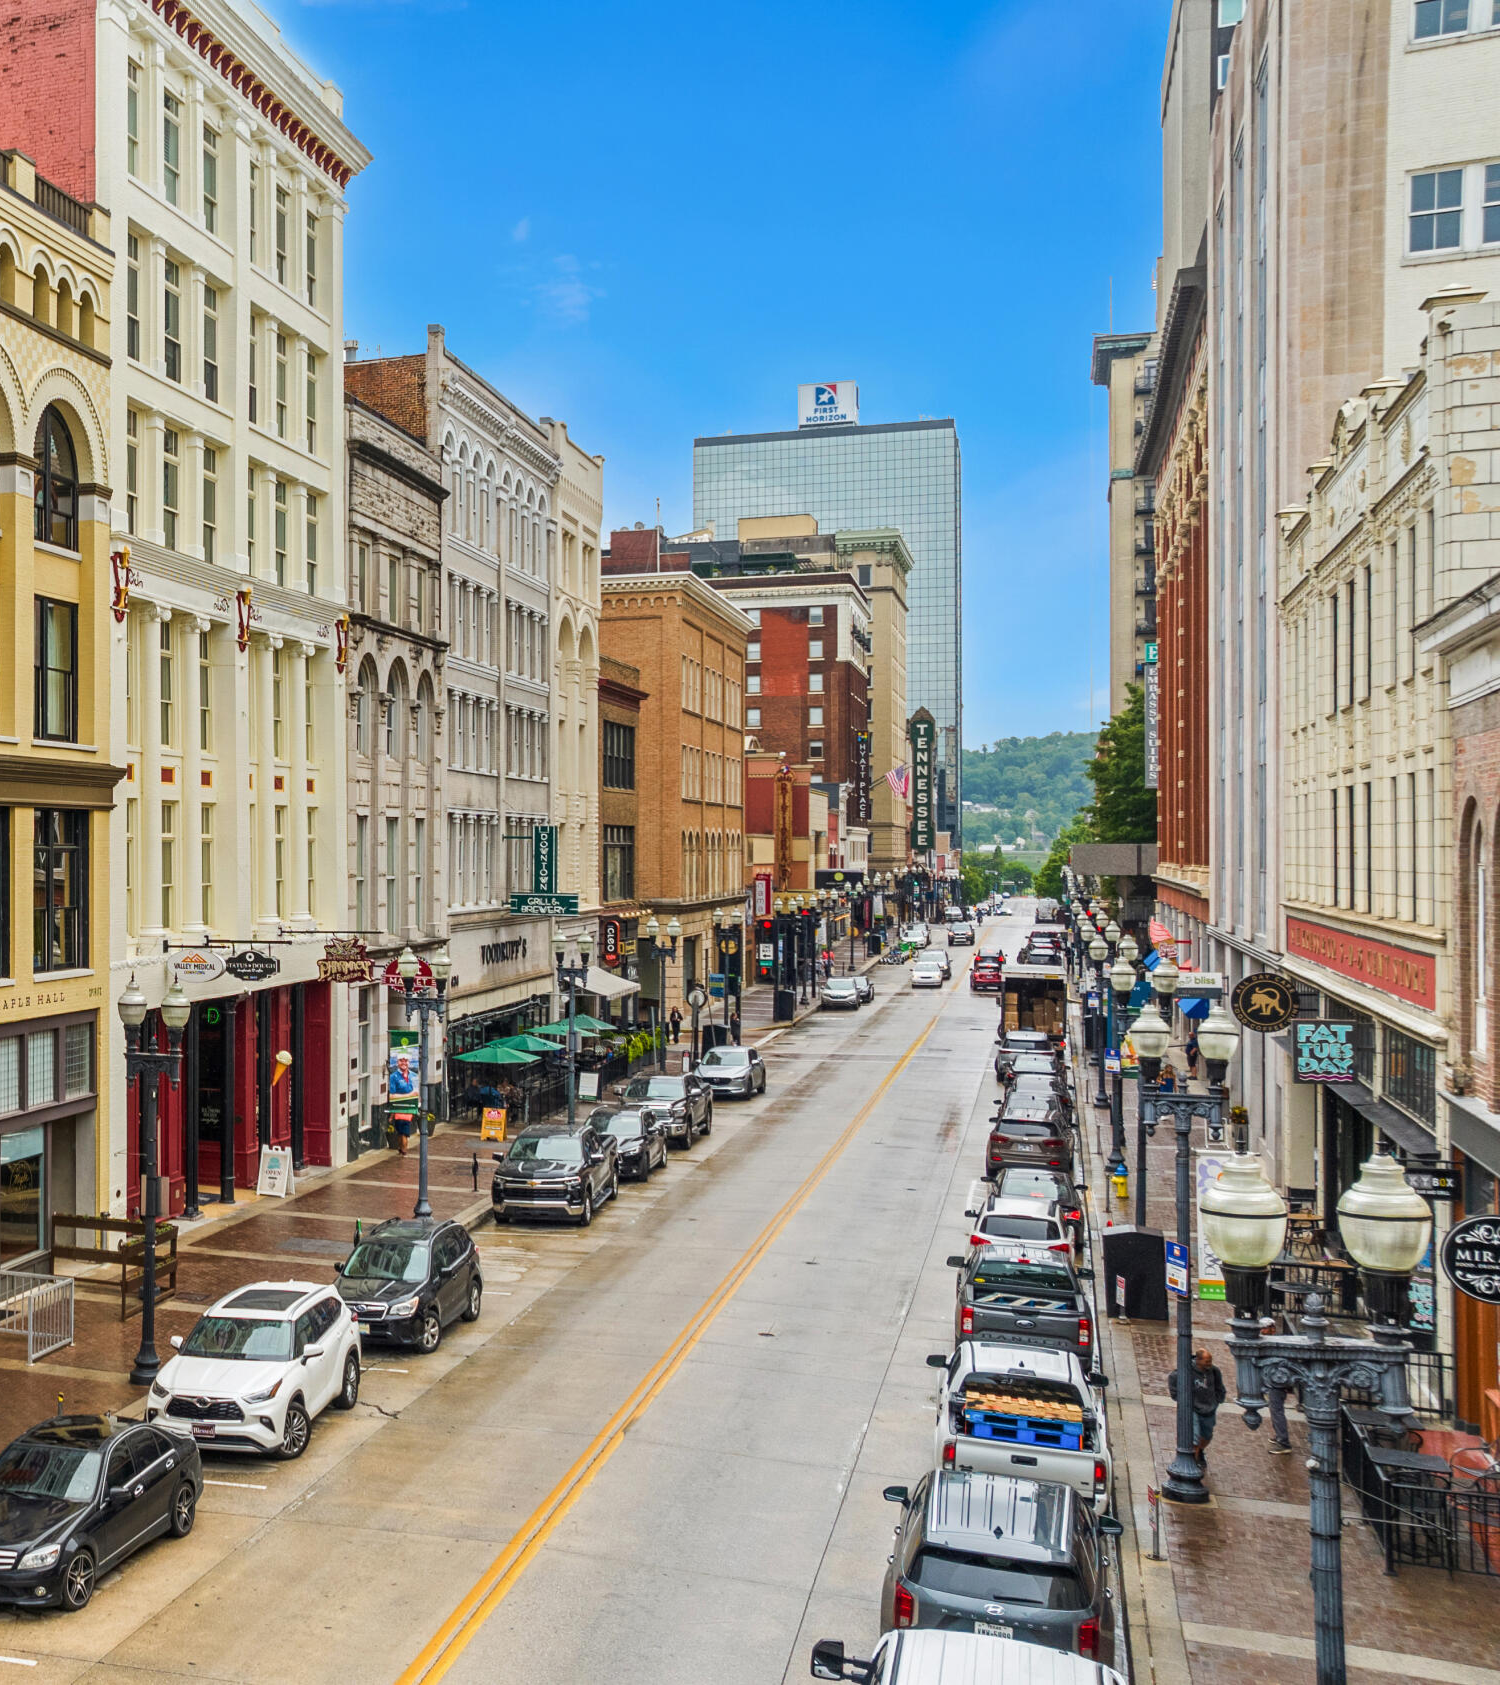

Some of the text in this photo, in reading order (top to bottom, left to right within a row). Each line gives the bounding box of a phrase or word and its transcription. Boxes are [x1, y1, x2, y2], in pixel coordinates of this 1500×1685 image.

[806, 414, 846, 422] HORIZON
[1148, 668, 1158, 725] EMBASSY
[1148, 731, 1158, 779] SUITES
[859, 744, 867, 818] HYATT PLACE
[916, 724, 928, 846] TENNESSEE
[539, 833, 549, 891] DOWNTOWN
[527, 897, 550, 905] GRILL
[521, 906, 566, 914] BREWERY
[317, 960, 372, 981] PHARMACY
[1366, 949, 1390, 982] CENT
[1393, 957, 1426, 995] STORE
[389, 977, 427, 985] MAET
[1194, 976, 1215, 985] bliss
[37, 992, 66, 1005] HALL
[1297, 1024, 1353, 1043] FAT
[1297, 1042, 1354, 1058] TUES
[1406, 1173, 1454, 1188] KYBOX
[1455, 1249, 1500, 1263] MIR
